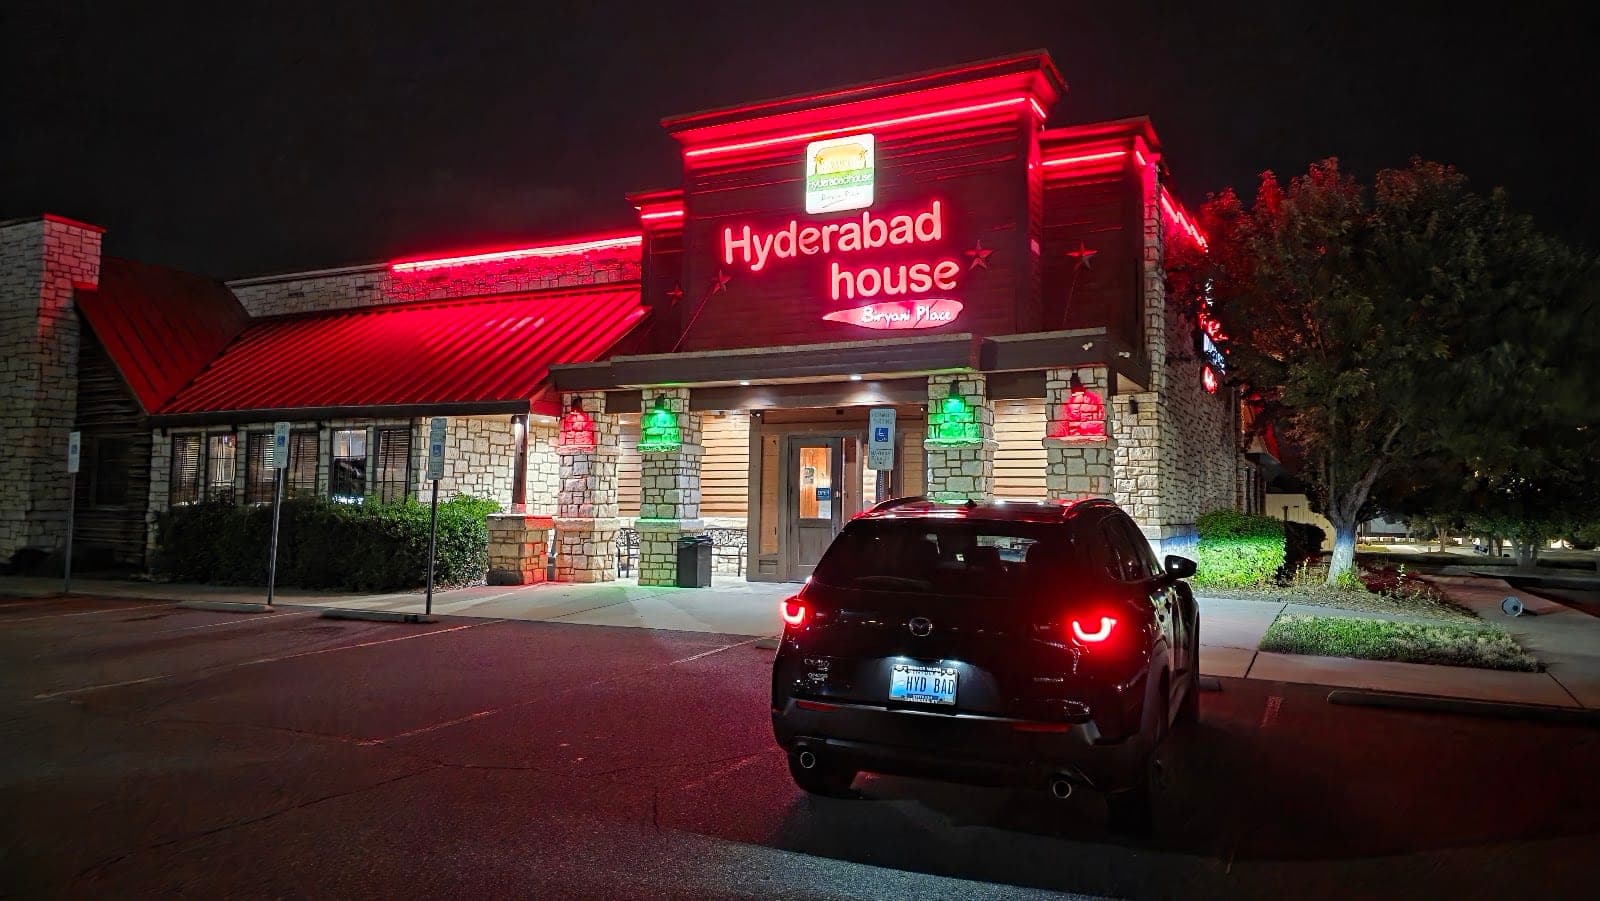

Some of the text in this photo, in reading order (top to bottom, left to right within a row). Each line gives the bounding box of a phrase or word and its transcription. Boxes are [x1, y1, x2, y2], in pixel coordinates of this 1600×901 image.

[724, 200, 942, 271] Hyderabad
[831, 260, 960, 300] house
[861, 304, 951, 327] Biryani Place
[906, 676, 955, 695] HYD BAD
